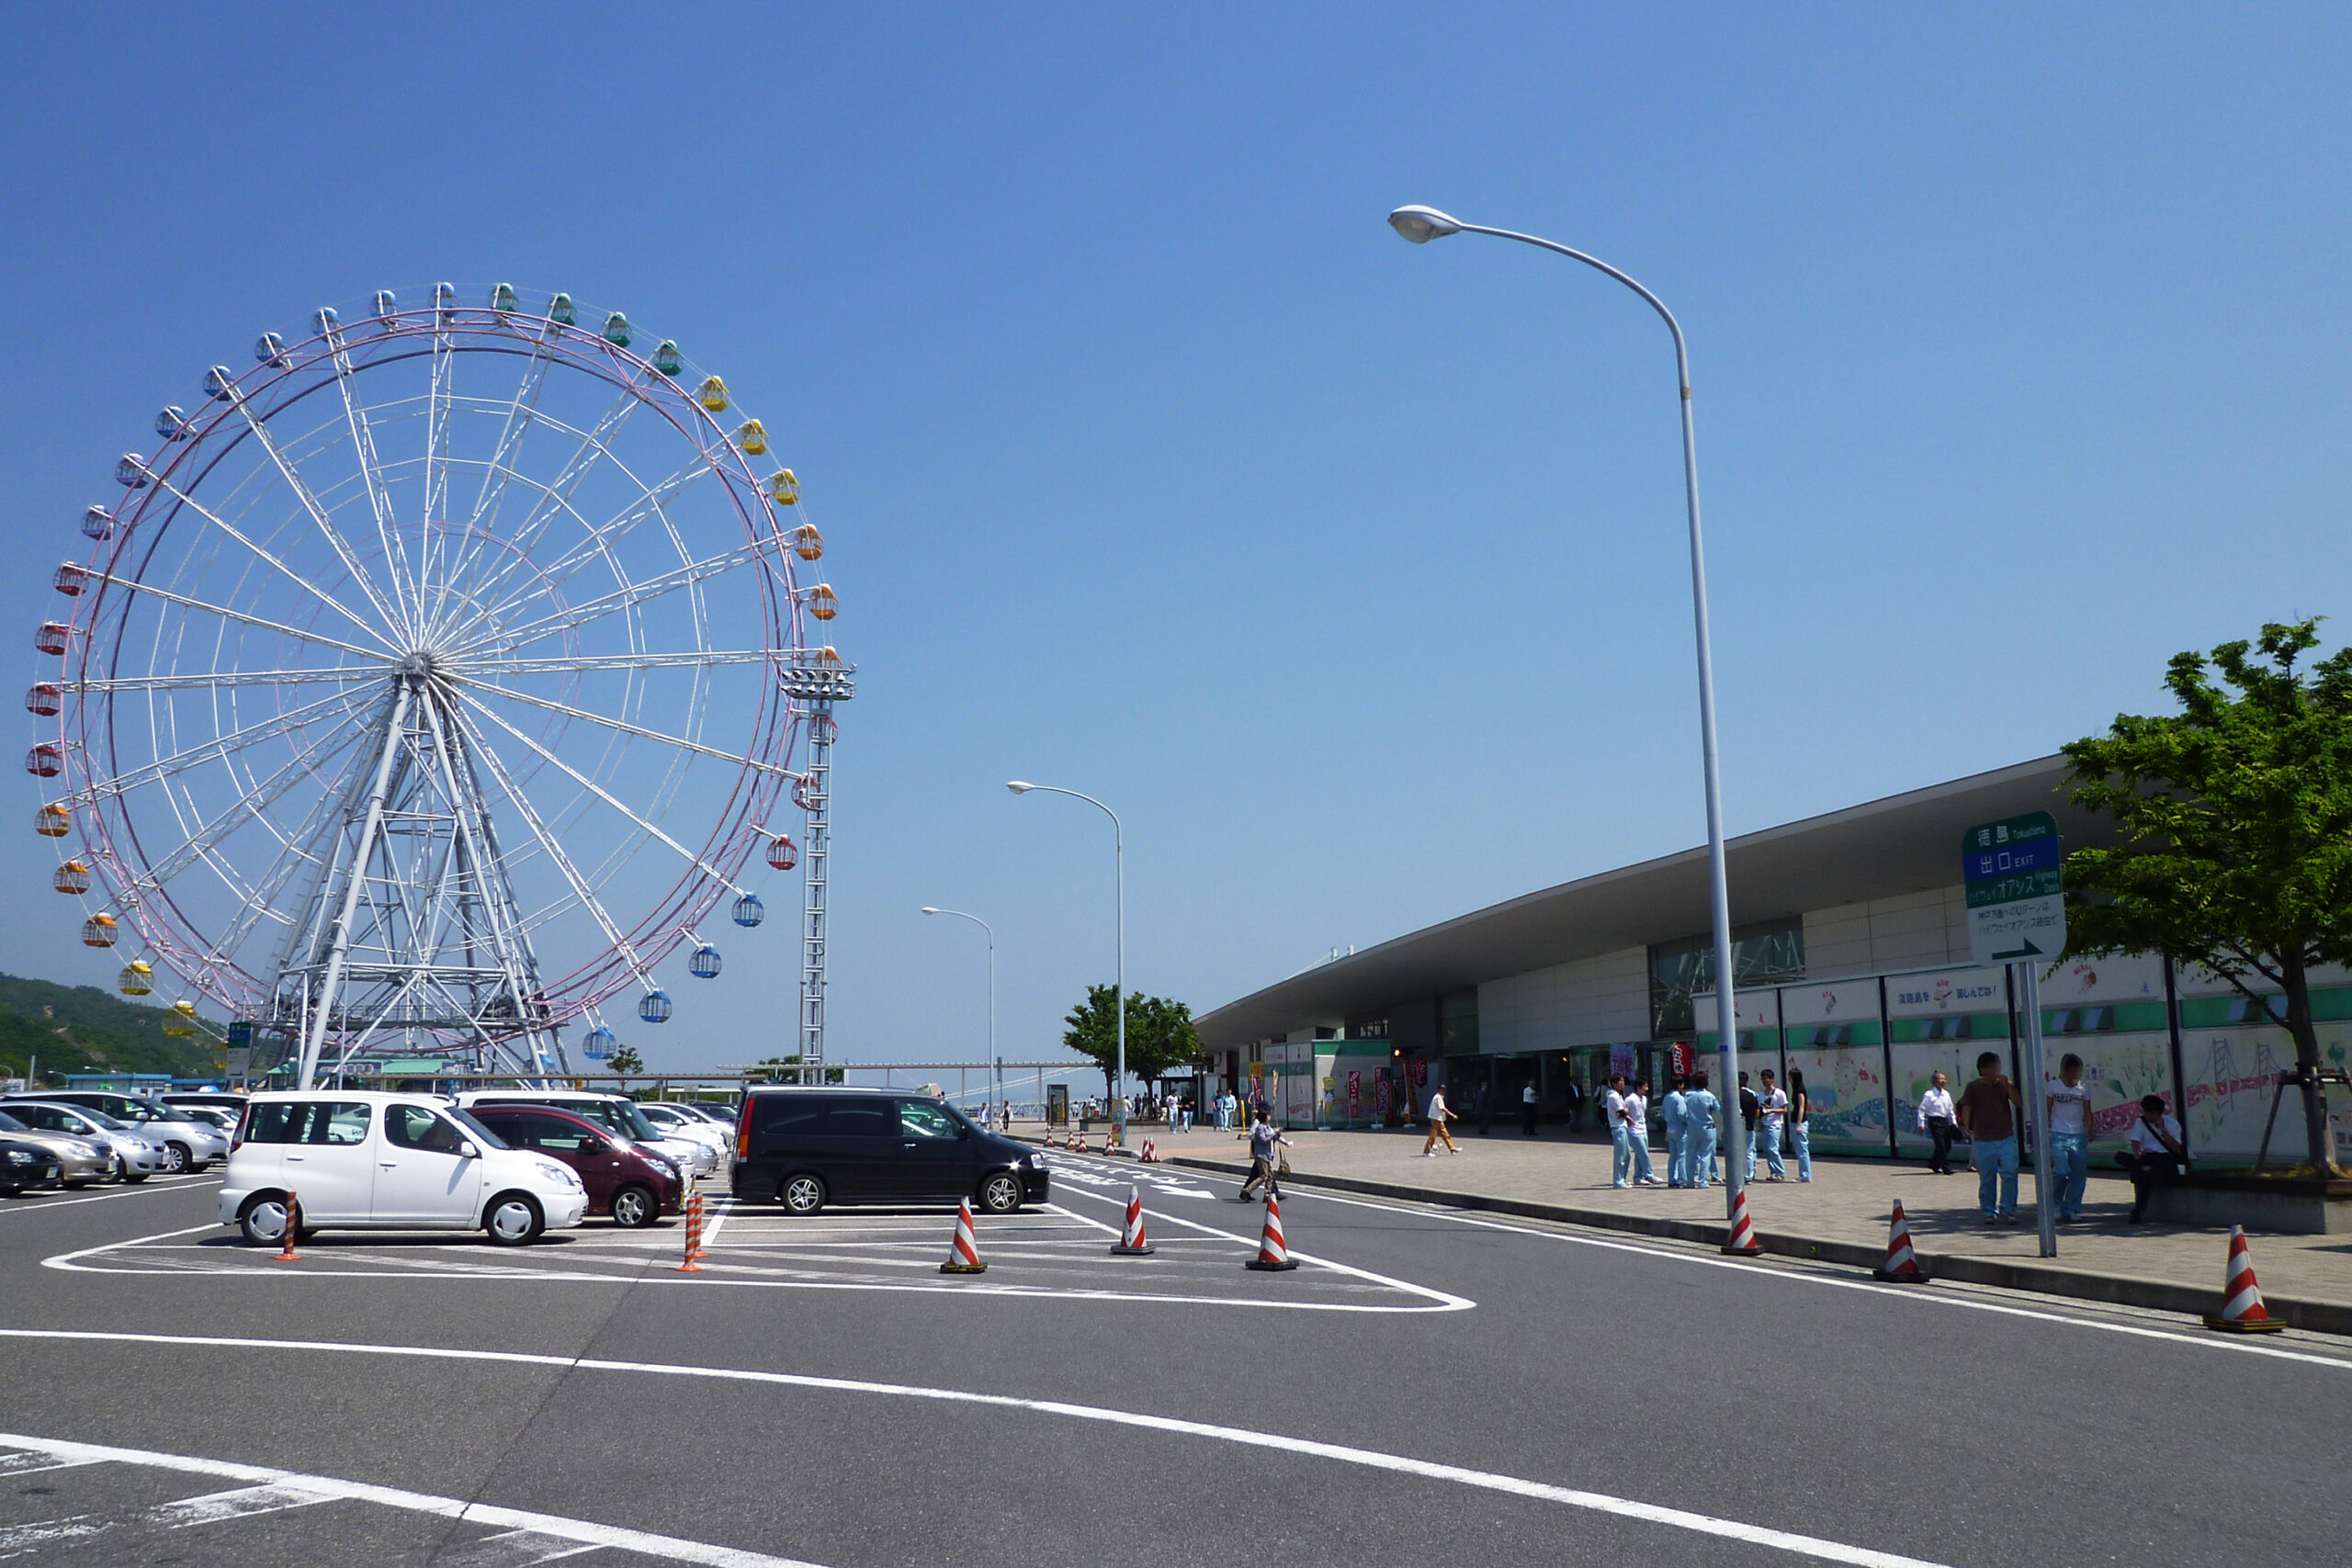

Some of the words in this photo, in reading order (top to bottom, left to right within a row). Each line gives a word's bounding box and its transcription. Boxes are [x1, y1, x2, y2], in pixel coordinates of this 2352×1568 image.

[1978, 825, 2008, 846] 徳島
[1981, 852, 2011, 874] 出口
[2015, 854, 2034, 867] EXIT
